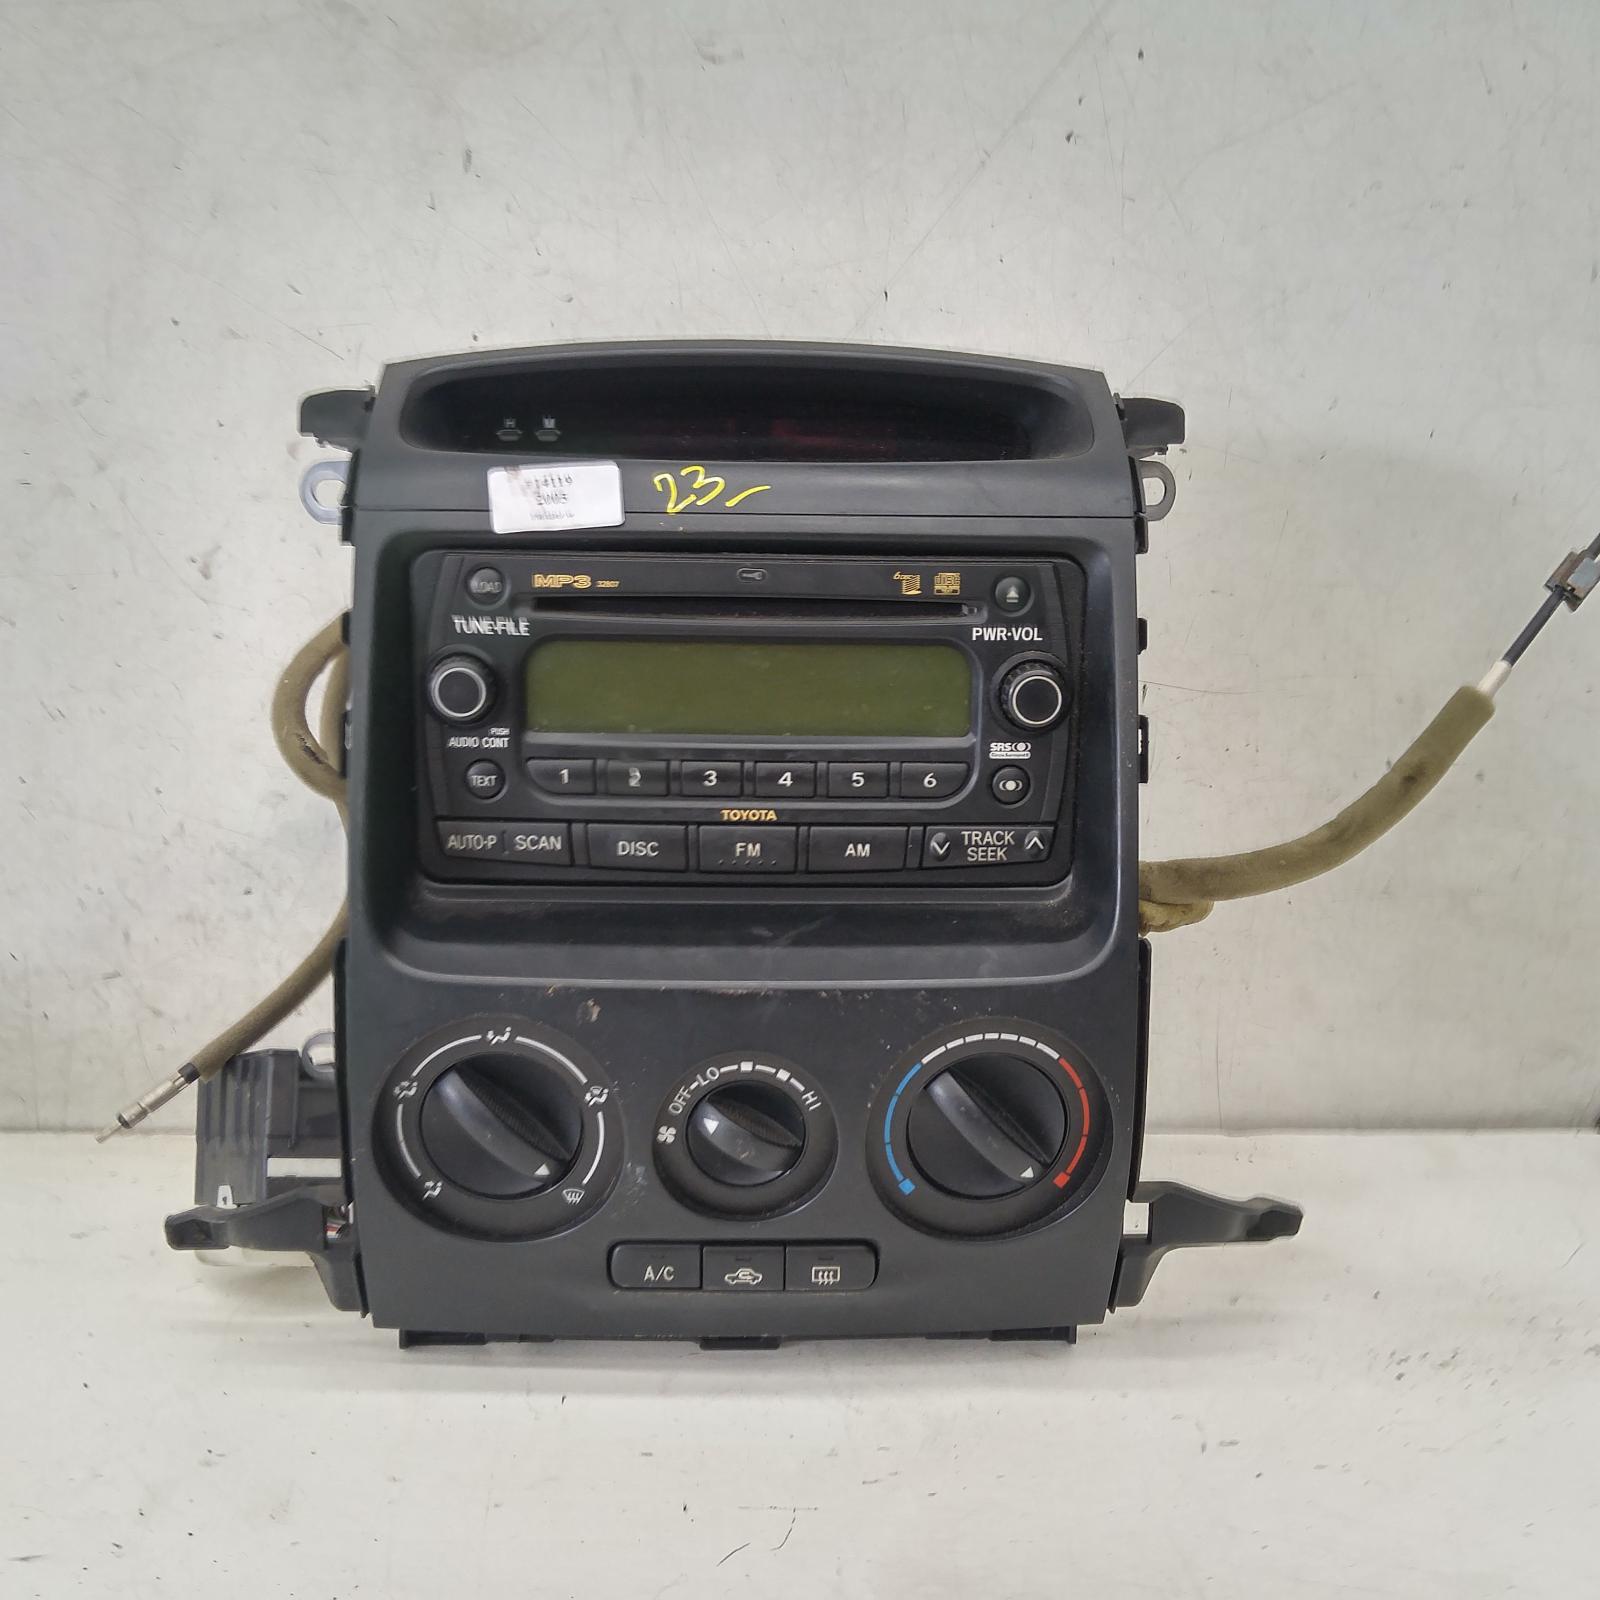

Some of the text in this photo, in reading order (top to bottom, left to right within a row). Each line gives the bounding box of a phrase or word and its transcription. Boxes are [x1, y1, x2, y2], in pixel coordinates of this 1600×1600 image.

[532, 574, 592, 589] MP3
[448, 736, 510, 748] AUDIO CONT
[990, 742, 1012, 752] SRS
[471, 774, 497, 787] TEXT
[559, 769, 569, 784] 1
[628, 768, 641, 787] 2
[703, 770, 717, 787] 3
[778, 772, 793, 788] 4
[851, 772, 865, 788] 5
[923, 772, 937, 788] 6
[720, 809, 778, 821] TOYOTA
[514, 835, 562, 850] SCAN
[961, 830, 1015, 846] TRACK
[617, 841, 660, 857] DISC
[735, 842, 761, 857] FM
[845, 843, 871, 858] AM
[967, 847, 1008, 862] SEEK
[697, 1066, 720, 1086] LO
[668, 1086, 692, 1115] OFF
[801, 1090, 822, 1111] HI
[644, 1265, 675, 1281] A/C
